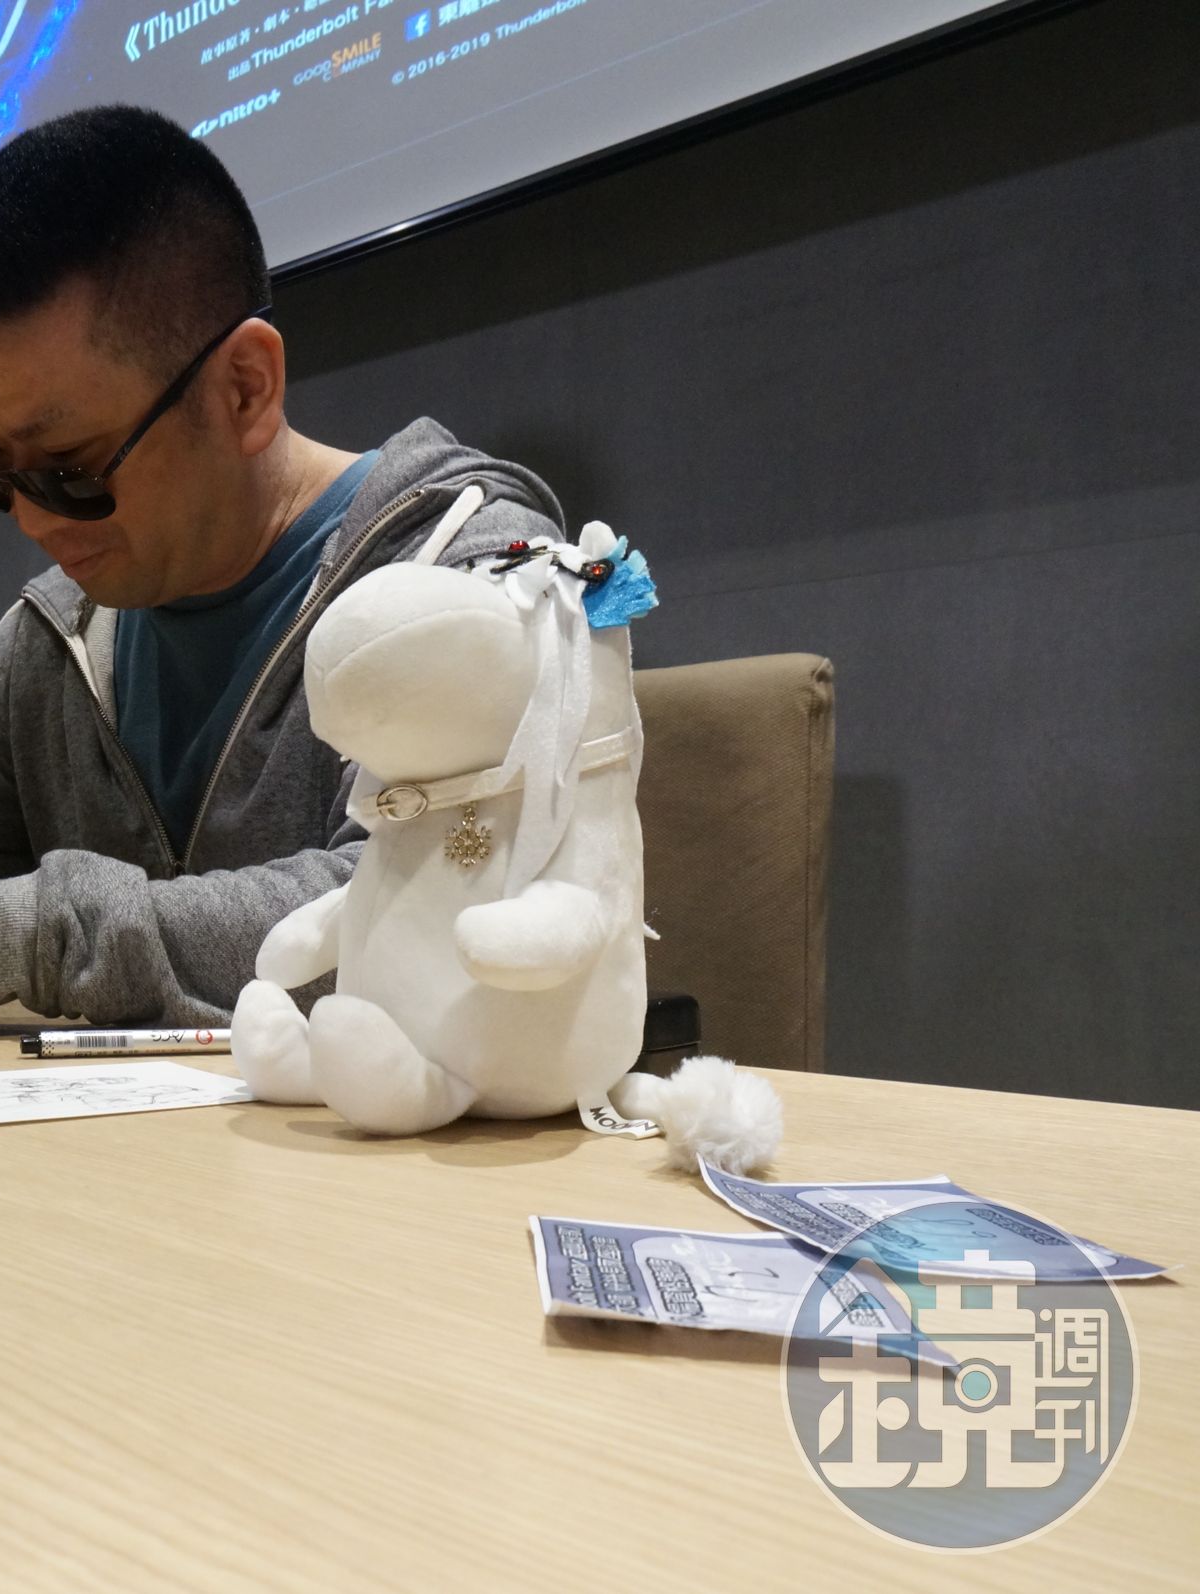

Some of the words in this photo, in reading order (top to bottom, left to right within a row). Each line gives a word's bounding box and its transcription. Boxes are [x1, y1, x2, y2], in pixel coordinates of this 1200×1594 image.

[251, 5, 359, 68] Thunderbolt
[364, 0, 395, 15] Fa
[331, 32, 382, 68] SMILE
[408, 33, 491, 79] 2016-2019
[495, 0, 587, 39] Thunderbo
